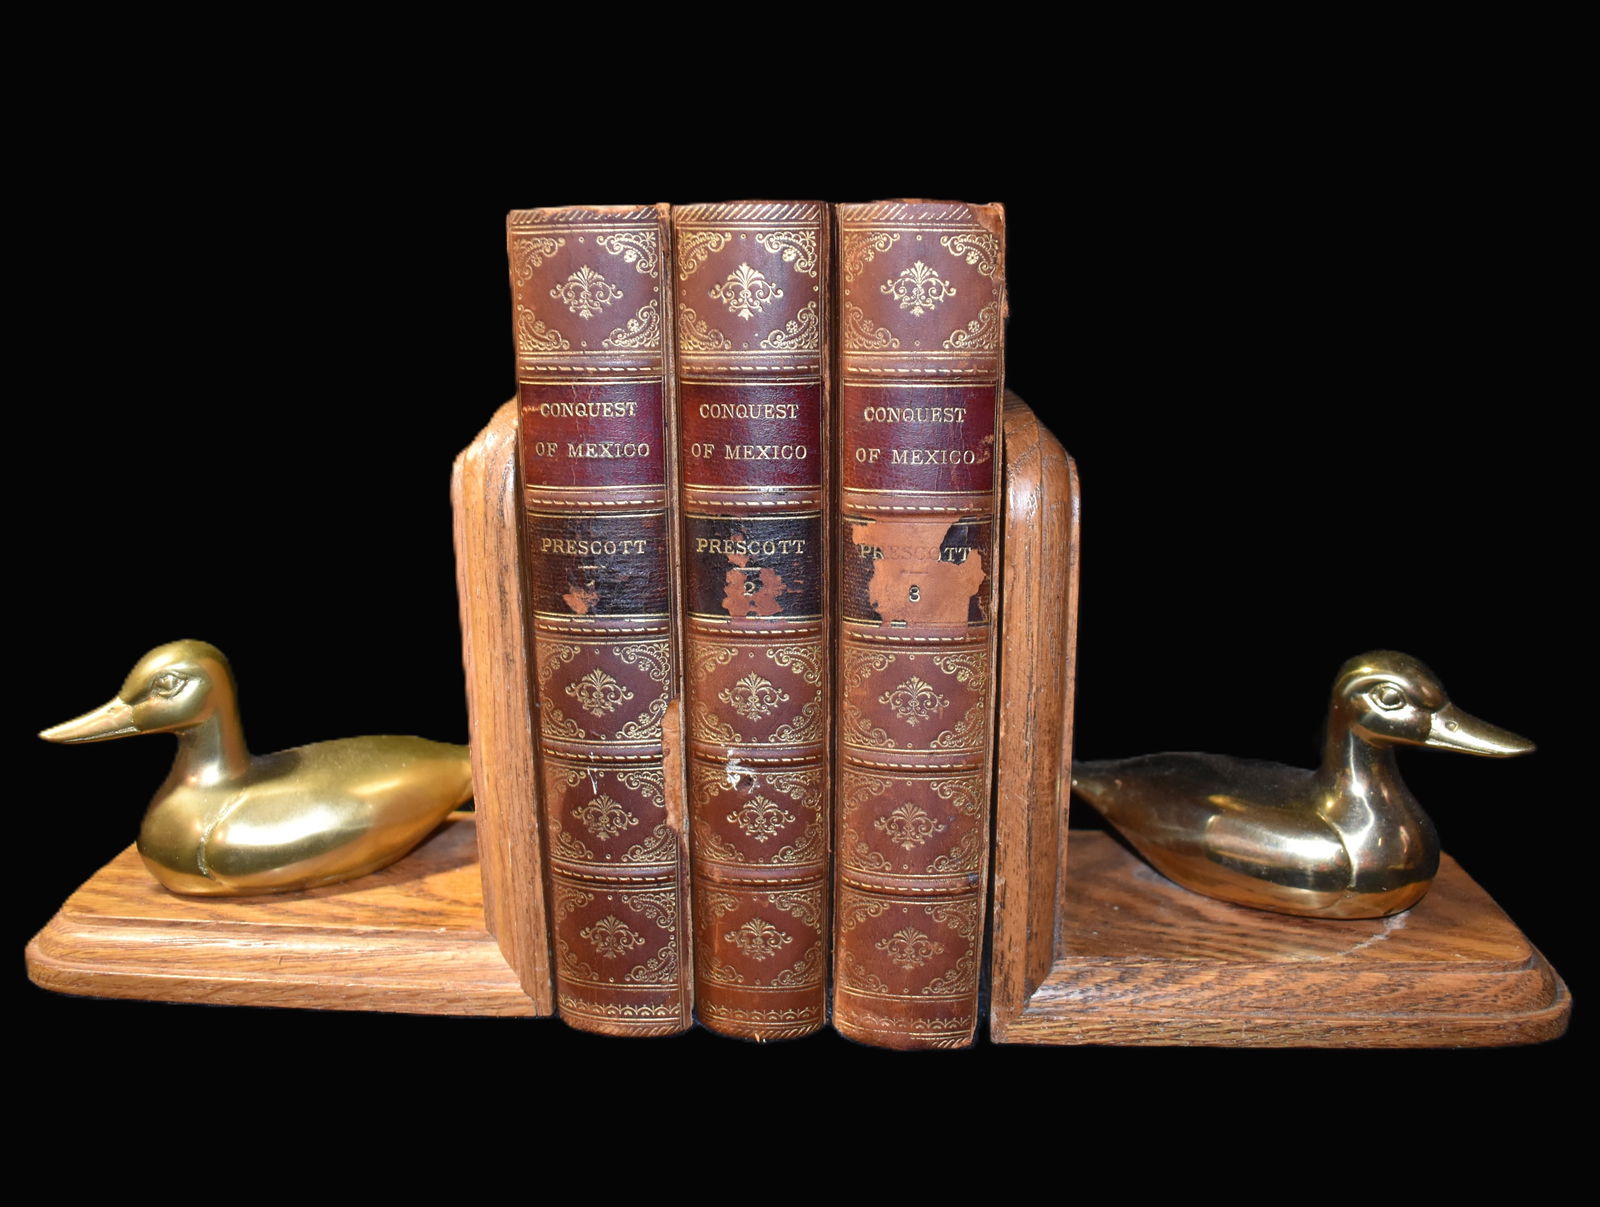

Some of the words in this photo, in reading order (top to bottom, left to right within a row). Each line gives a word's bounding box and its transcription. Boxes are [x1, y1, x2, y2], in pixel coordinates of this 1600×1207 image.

[540, 402, 638, 417] CONQUEST
[699, 403, 799, 419] CONQUEST
[863, 406, 967, 423] CONQUEST
[535, 442, 558, 457] OF
[567, 443, 651, 458] MEXICO
[691, 443, 715, 458] OF
[724, 444, 807, 460] MEXICO
[855, 447, 881, 463] OF
[891, 449, 976, 465] MEXICO
[541, 538, 647, 555] PRESCOTT
[695, 538, 806, 555] PRESCOTT
[743, 581, 756, 597] 2
